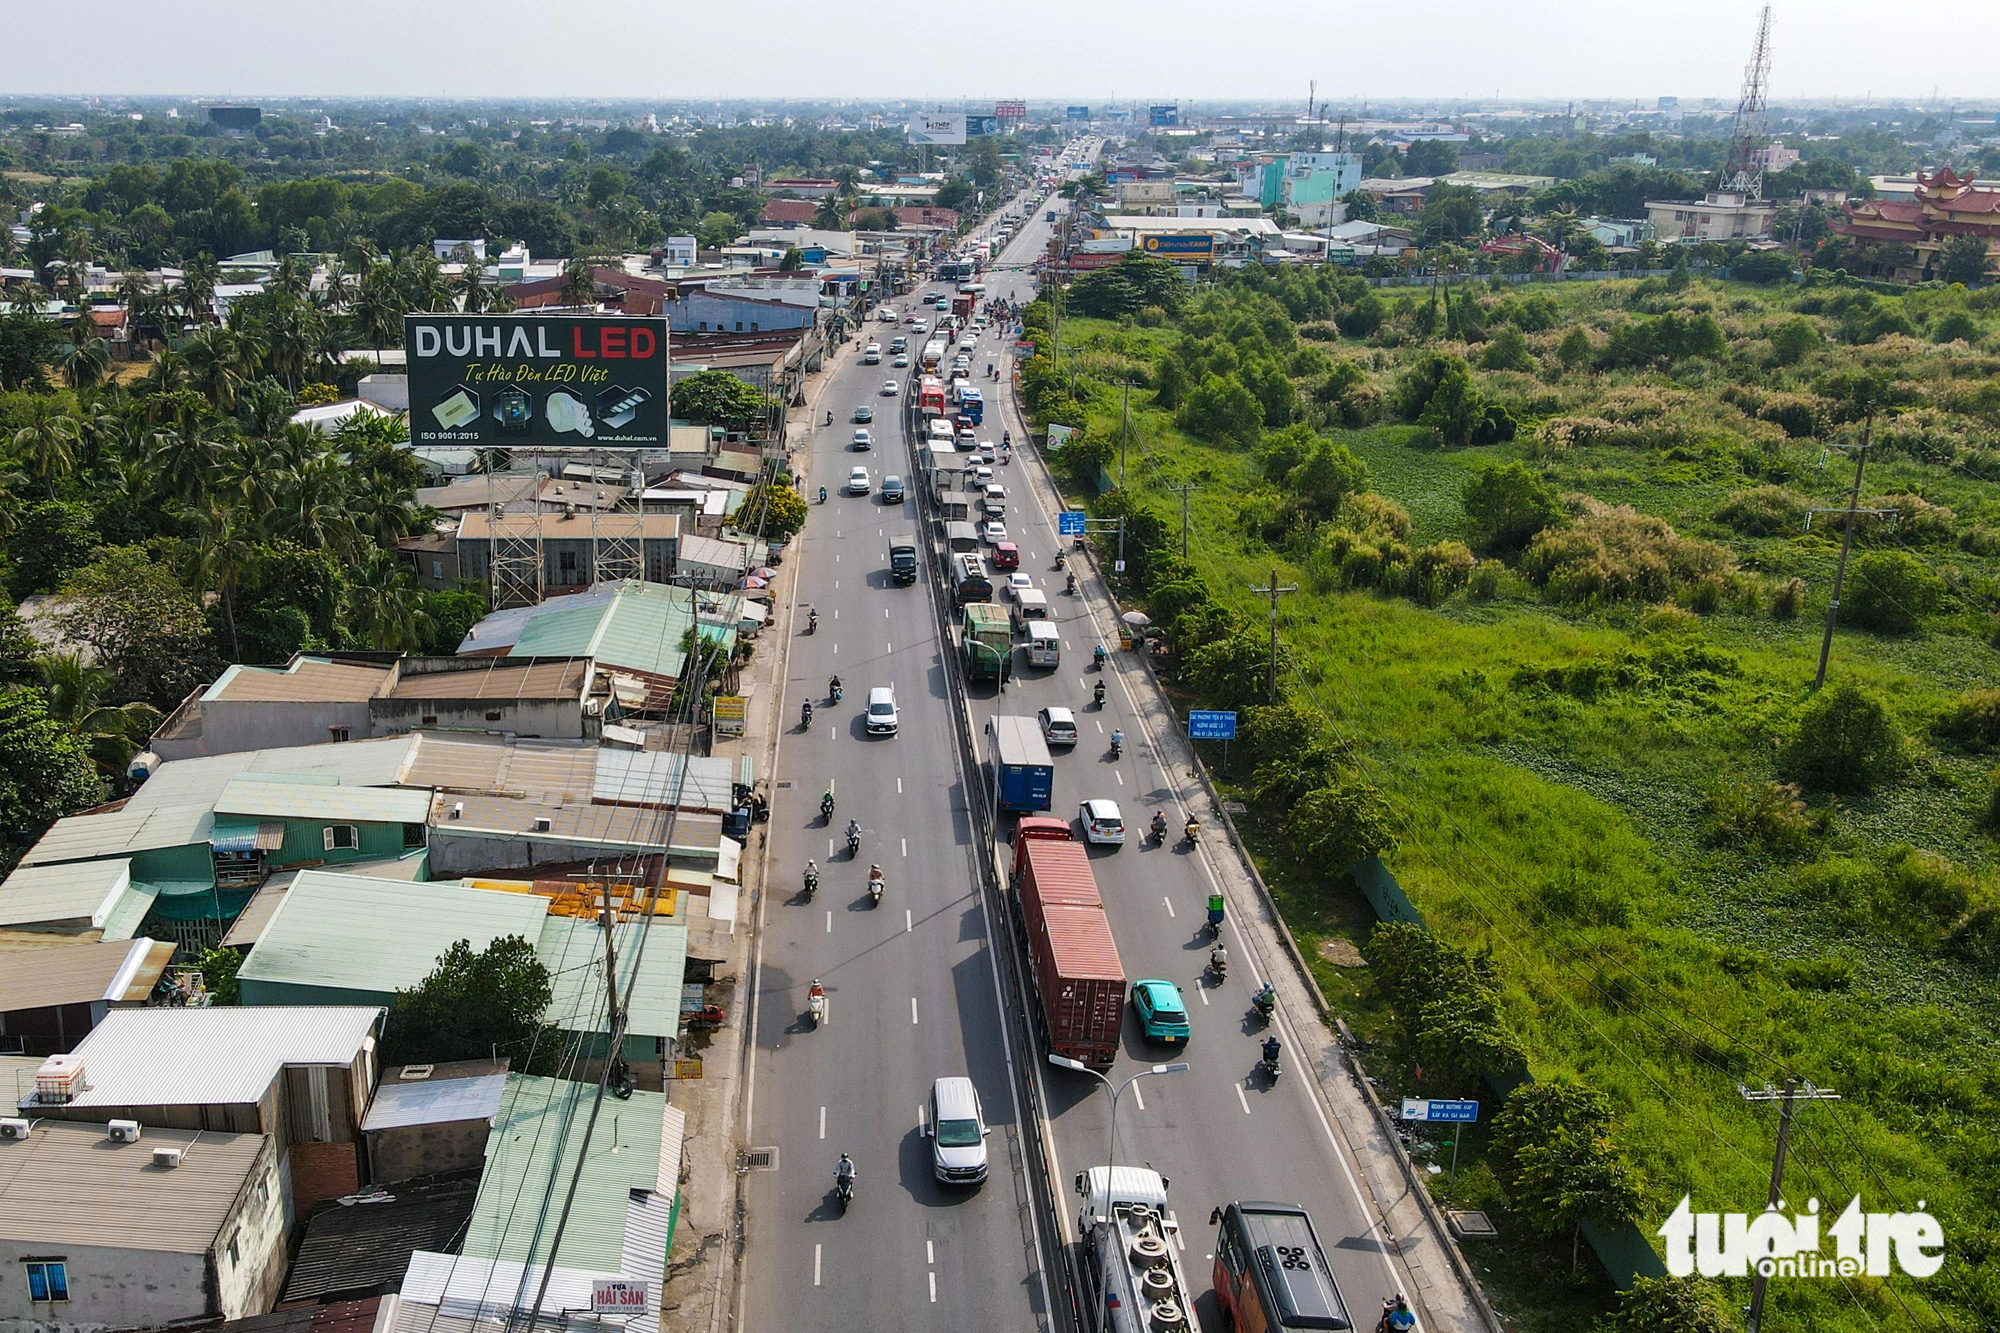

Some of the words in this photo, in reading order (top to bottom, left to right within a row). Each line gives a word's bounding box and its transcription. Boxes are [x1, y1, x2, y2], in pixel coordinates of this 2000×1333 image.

[415, 325, 561, 358] DUHAL
[573, 326, 656, 359] LED
[464, 363, 484, 385] Tự
[486, 363, 512, 382] Hào
[515, 364, 541, 382] Đèn
[543, 364, 577, 382] LED
[580, 366, 609, 386] Việt
[420, 432, 436, 440] ISO
[437, 432, 479, 440] 9001:2015
[597, 434, 658, 442] www.duhal.com.vn
[597, 1286, 617, 1305] HẢI
[620, 1287, 644, 1305] SẢN
